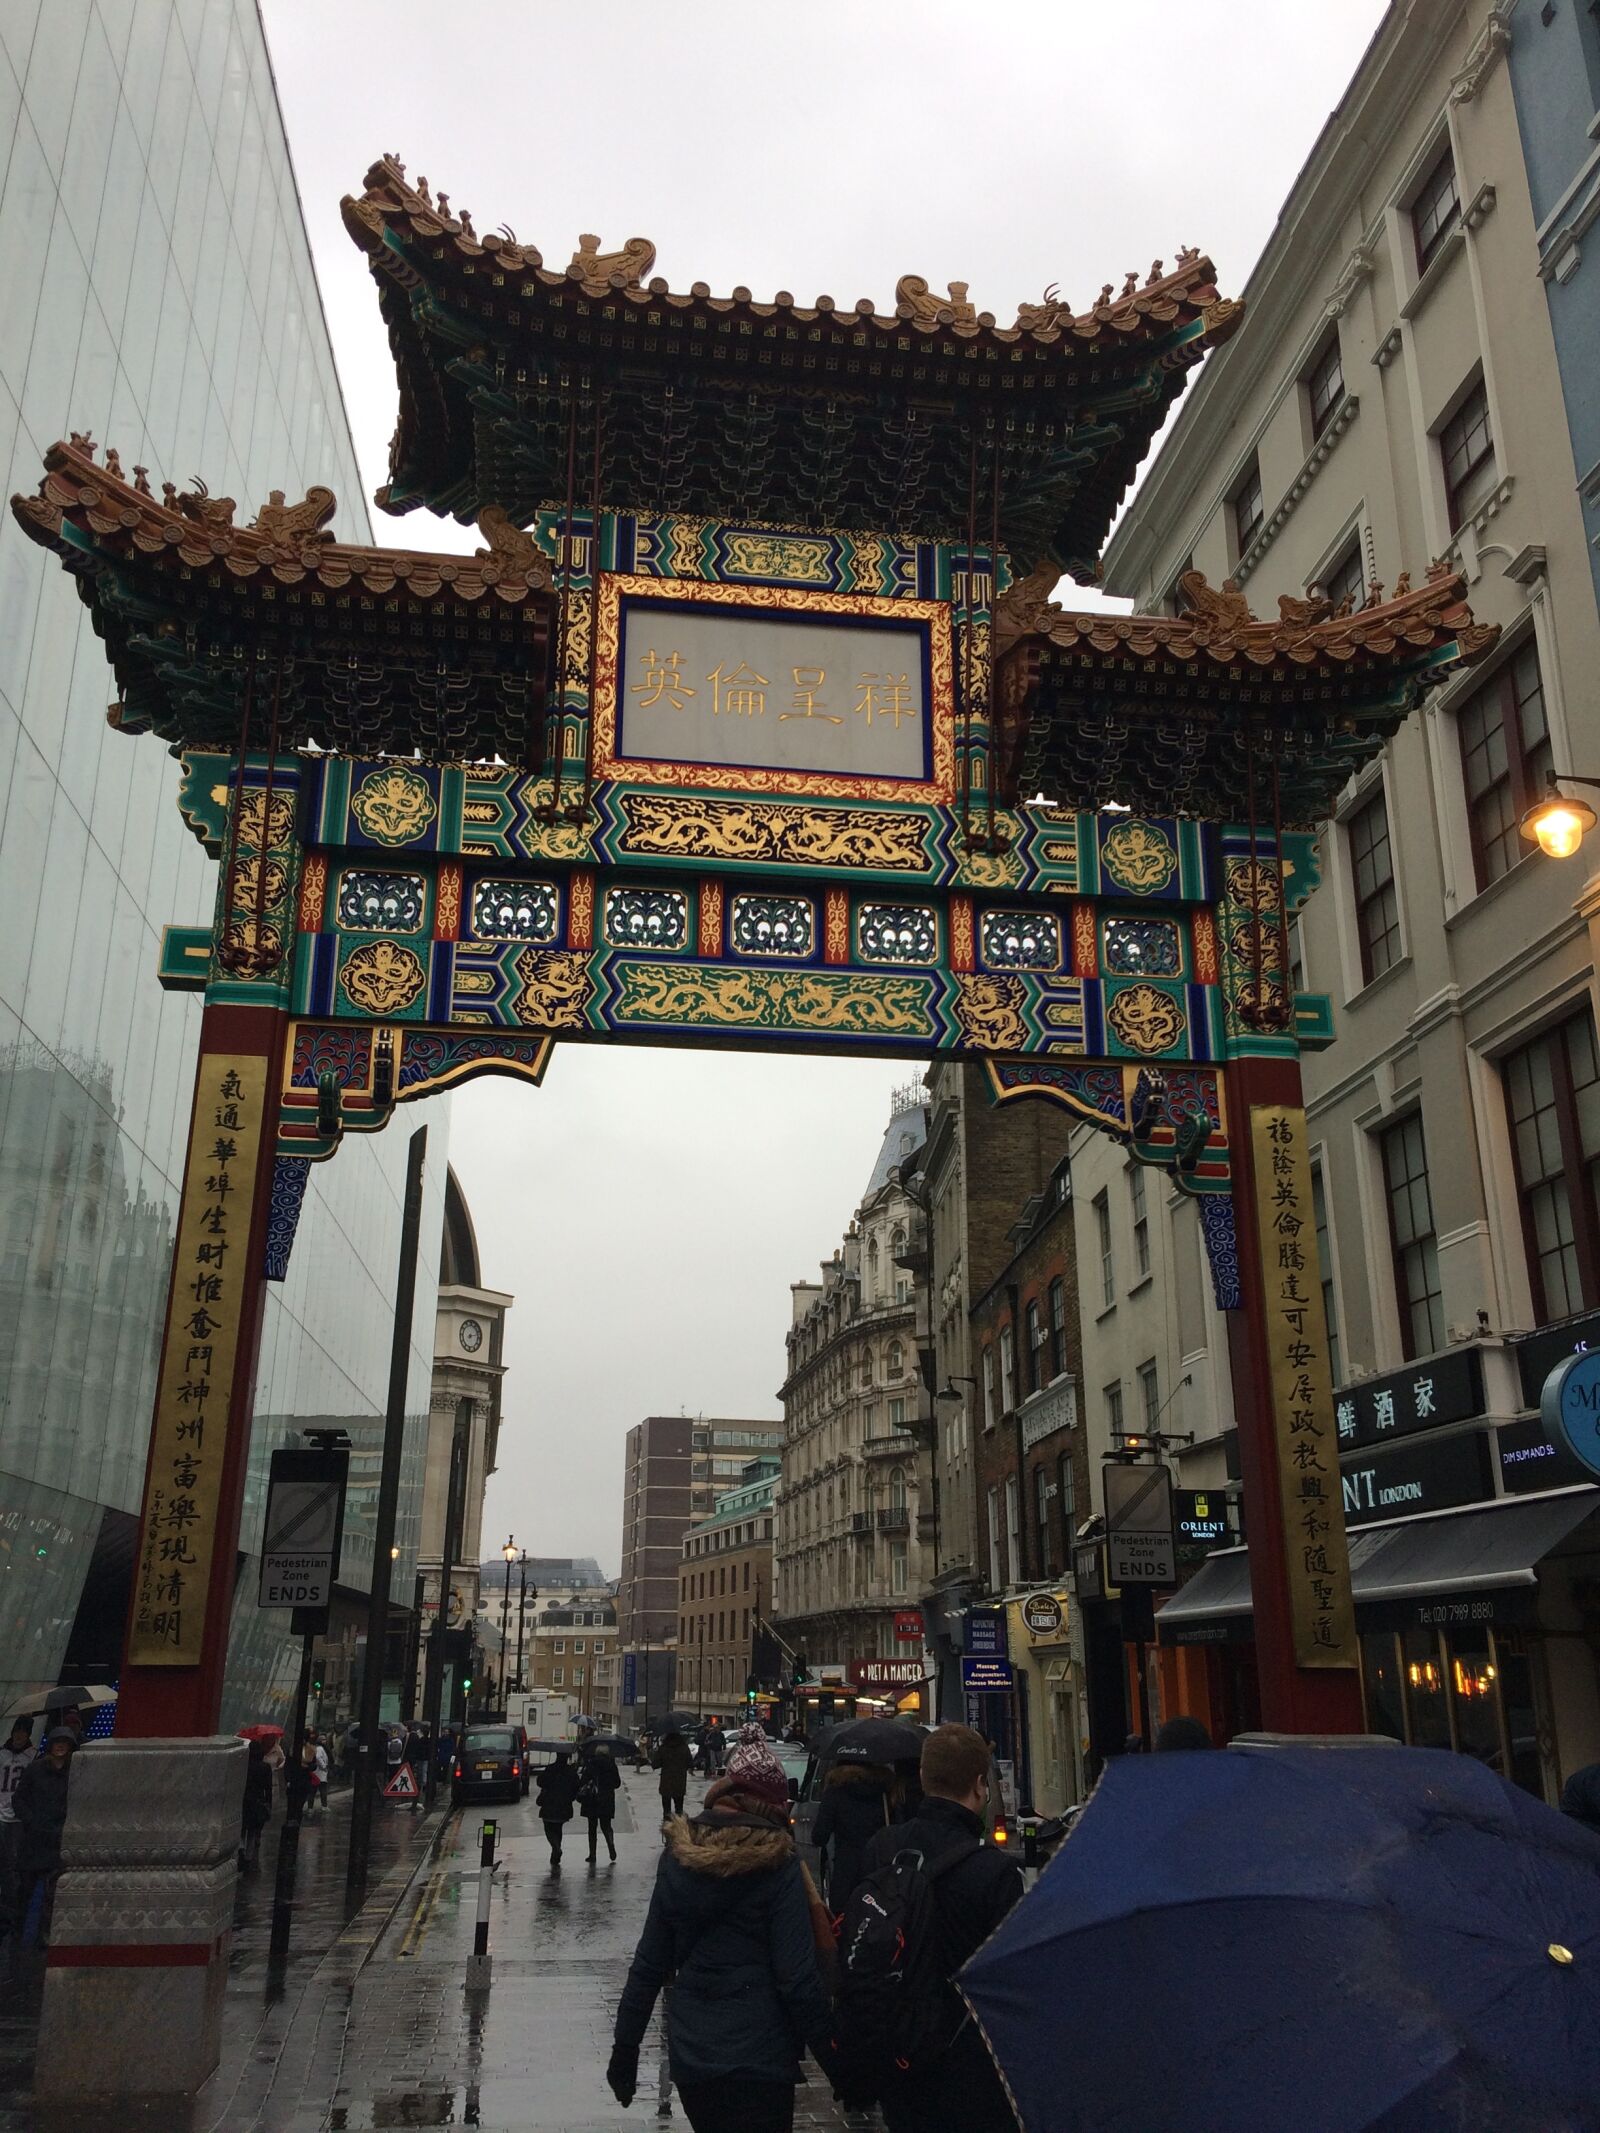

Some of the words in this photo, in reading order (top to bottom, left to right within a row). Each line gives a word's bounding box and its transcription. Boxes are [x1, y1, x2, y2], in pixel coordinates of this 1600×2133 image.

[631, 649, 917, 729] 英倫呈祥
[1503, 1452, 1515, 1464] DIM
[1516, 1449, 1530, 1462] SUM
[1530, 1445, 1545, 1459] AND
[1378, 1481, 1422, 1505] LONDON
[1180, 1521, 1225, 1532] ORIENT
[1113, 1535, 1169, 1545] Pedestrian
[1128, 1547, 1154, 1557] Zone
[267, 1557, 328, 1568] Pedestrian
[1120, 1562, 1167, 1576] ENDS
[282, 1570, 310, 1581] Zone
[269, 1586, 320, 1601] ENDS
[867, 1664, 882, 1681] PRET
[883, 1664, 889, 1681] A
[890, 1664, 922, 1681] MANGER
[976, 1663, 999, 1671] Massage
